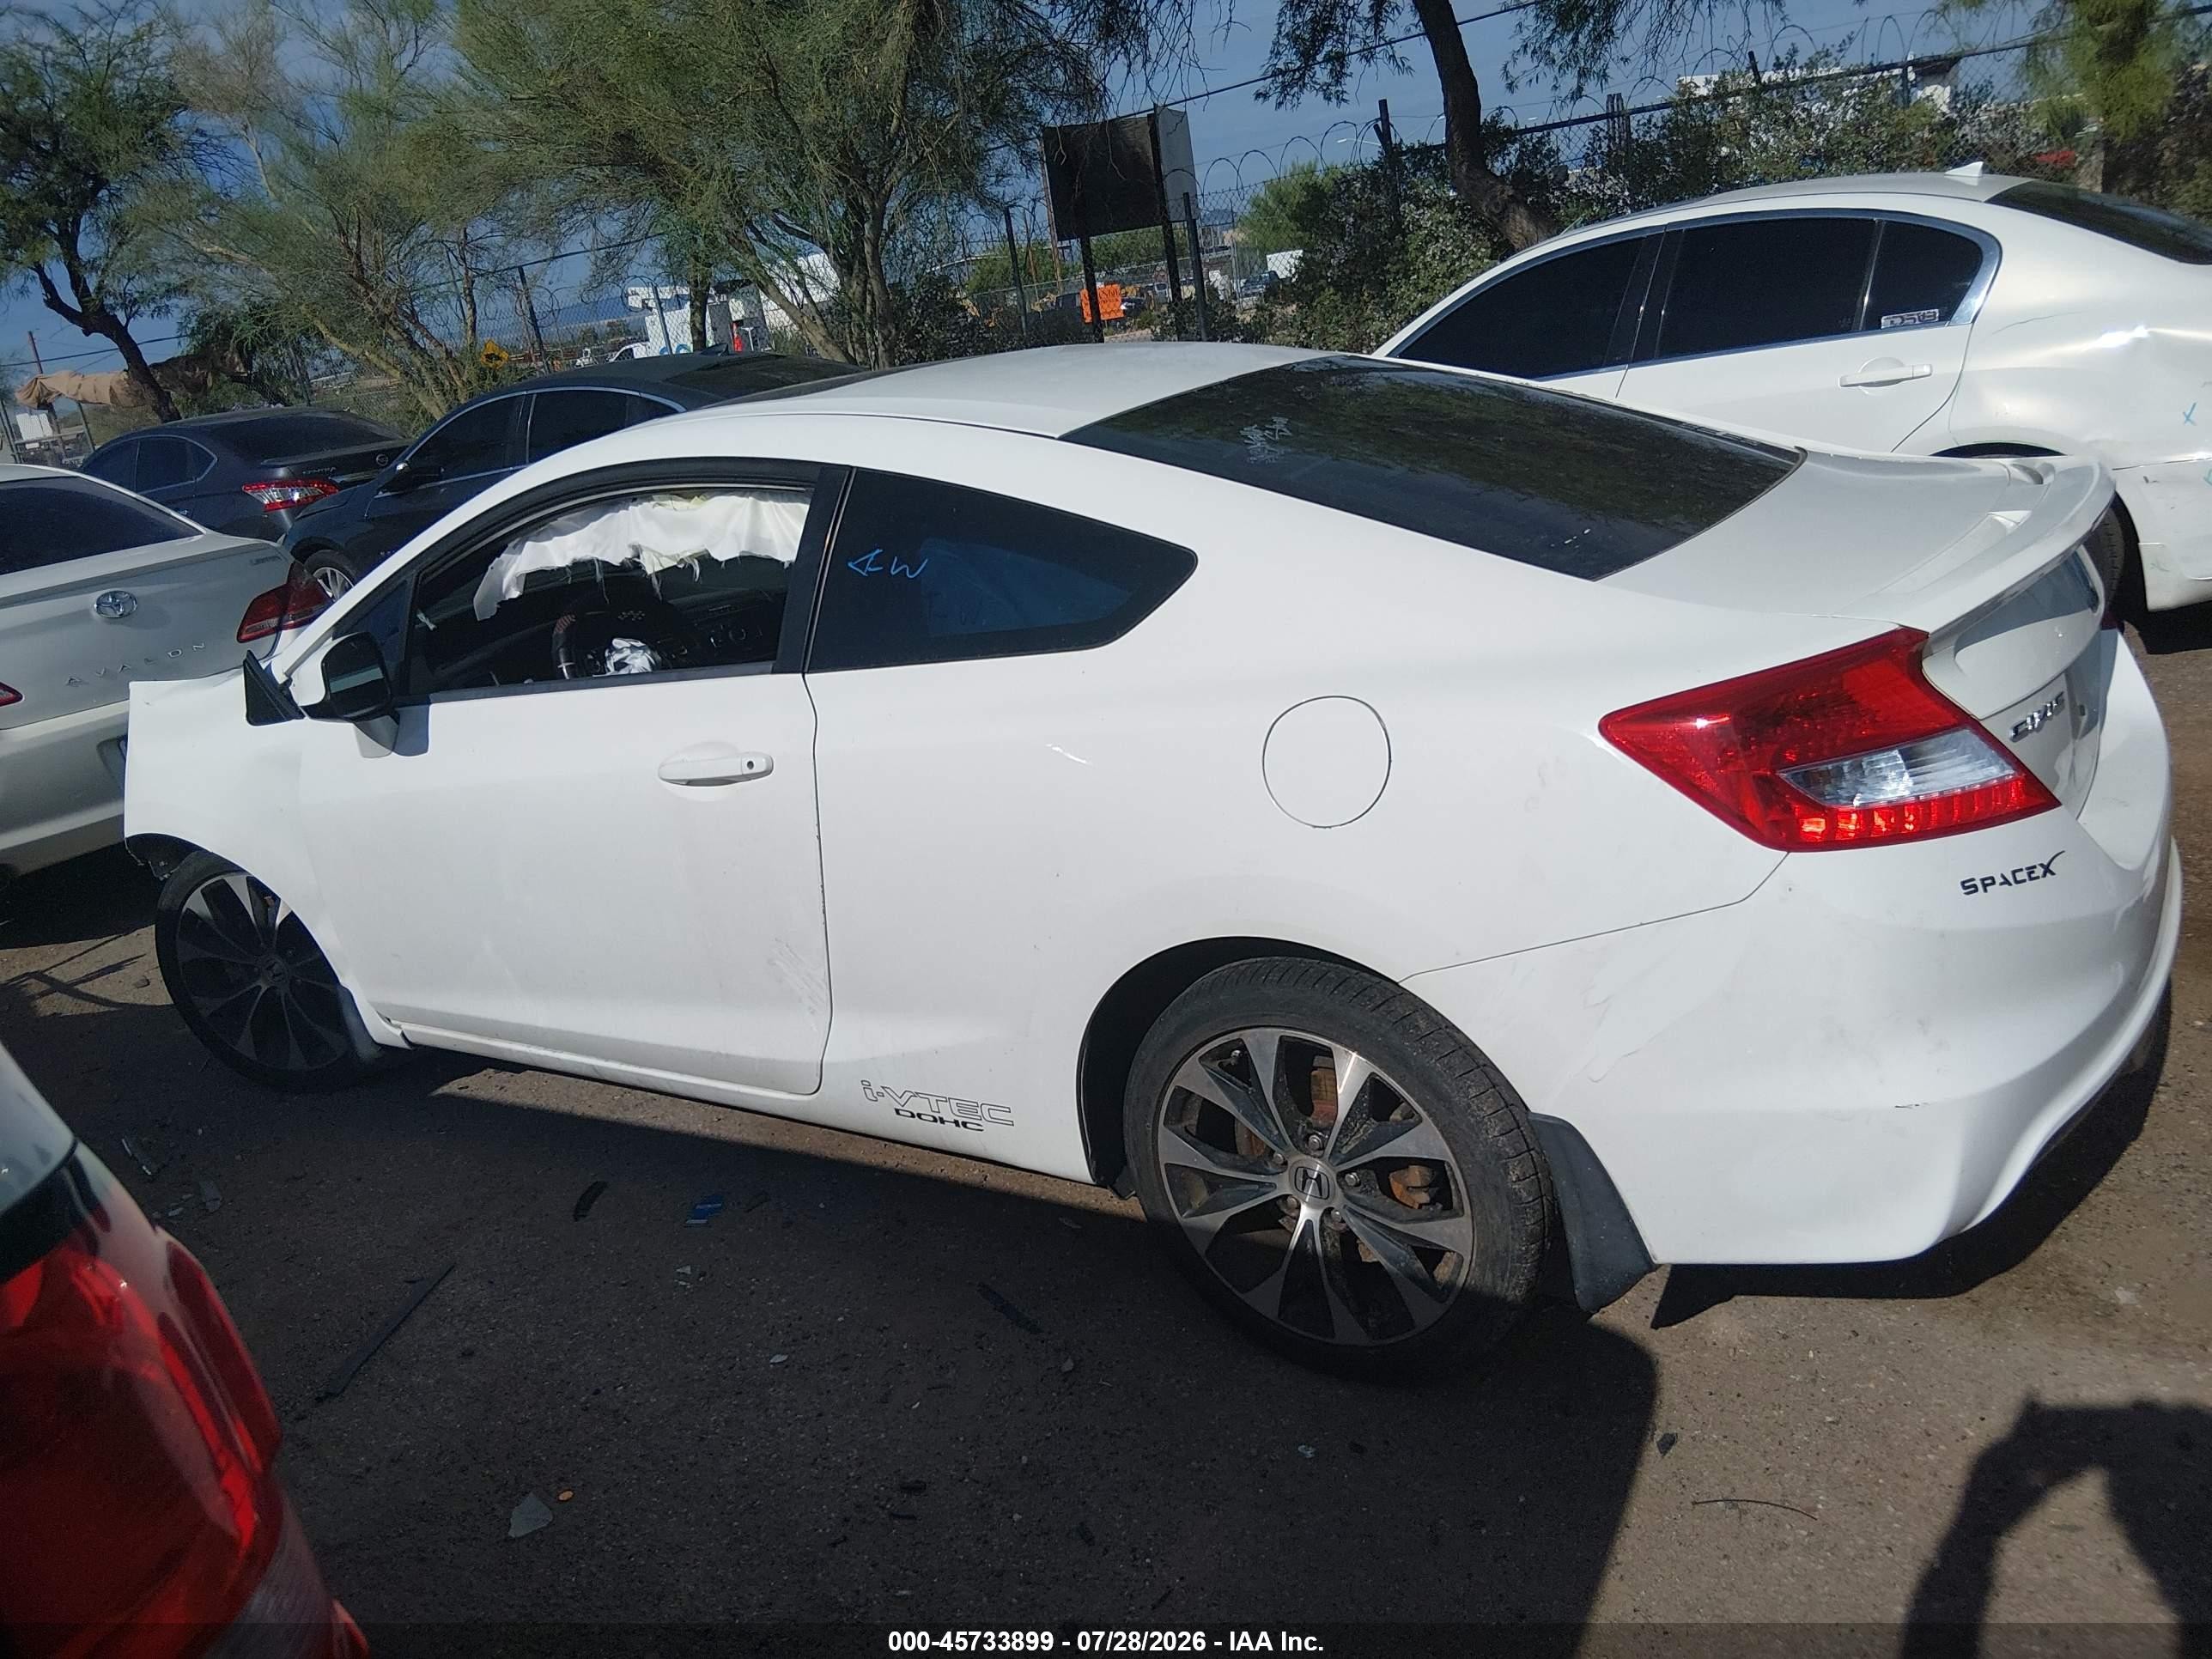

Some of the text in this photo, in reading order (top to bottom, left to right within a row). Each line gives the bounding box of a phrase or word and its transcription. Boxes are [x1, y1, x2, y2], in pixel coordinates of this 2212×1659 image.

[65, 642, 205, 685] AVALON
[1960, 850, 2065, 896] SPACEX
[860, 1079, 1015, 1127] i-VTEC
[894, 1108, 984, 1132] DOHC
